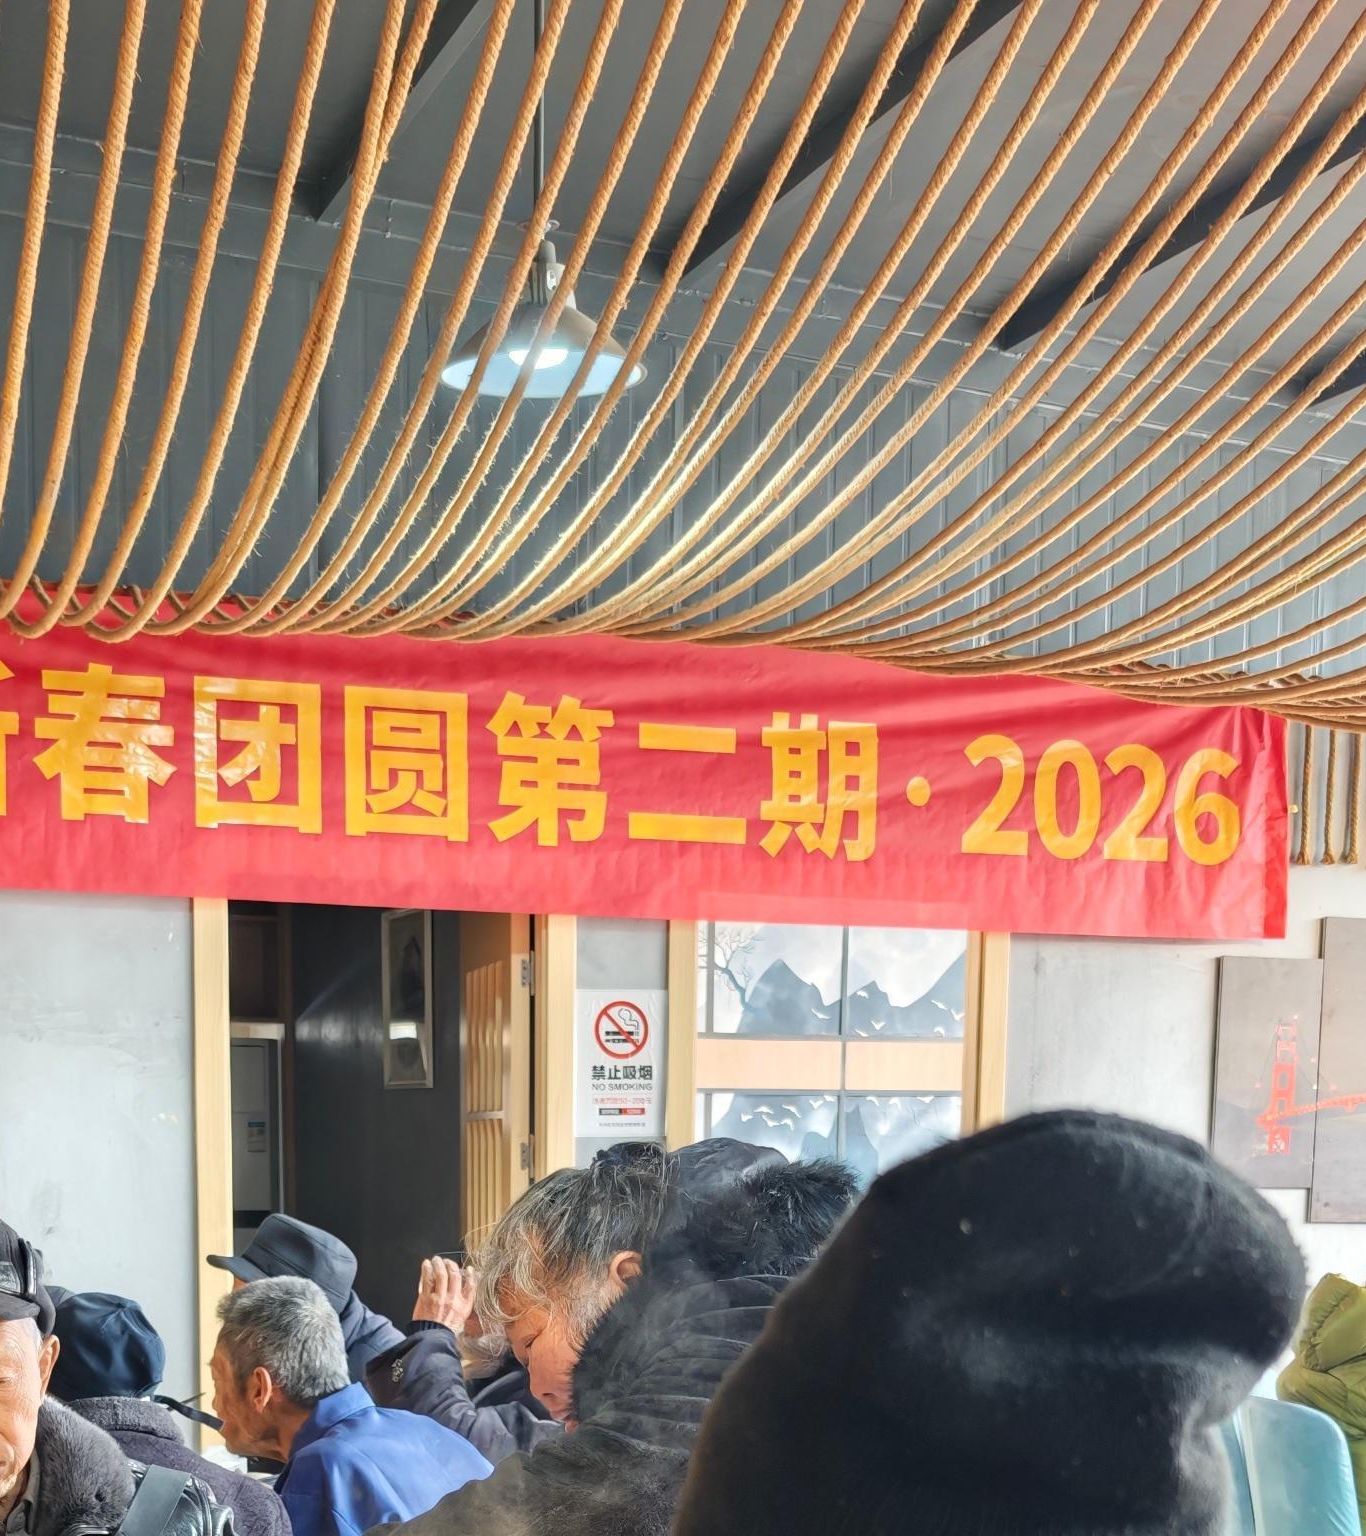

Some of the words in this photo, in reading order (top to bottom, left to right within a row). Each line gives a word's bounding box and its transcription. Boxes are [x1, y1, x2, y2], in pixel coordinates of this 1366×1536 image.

[591, 1065, 653, 1081] 禁止吸烟
[591, 1083, 606, 1091] NO
[608, 1083, 653, 1091] SMOKING
